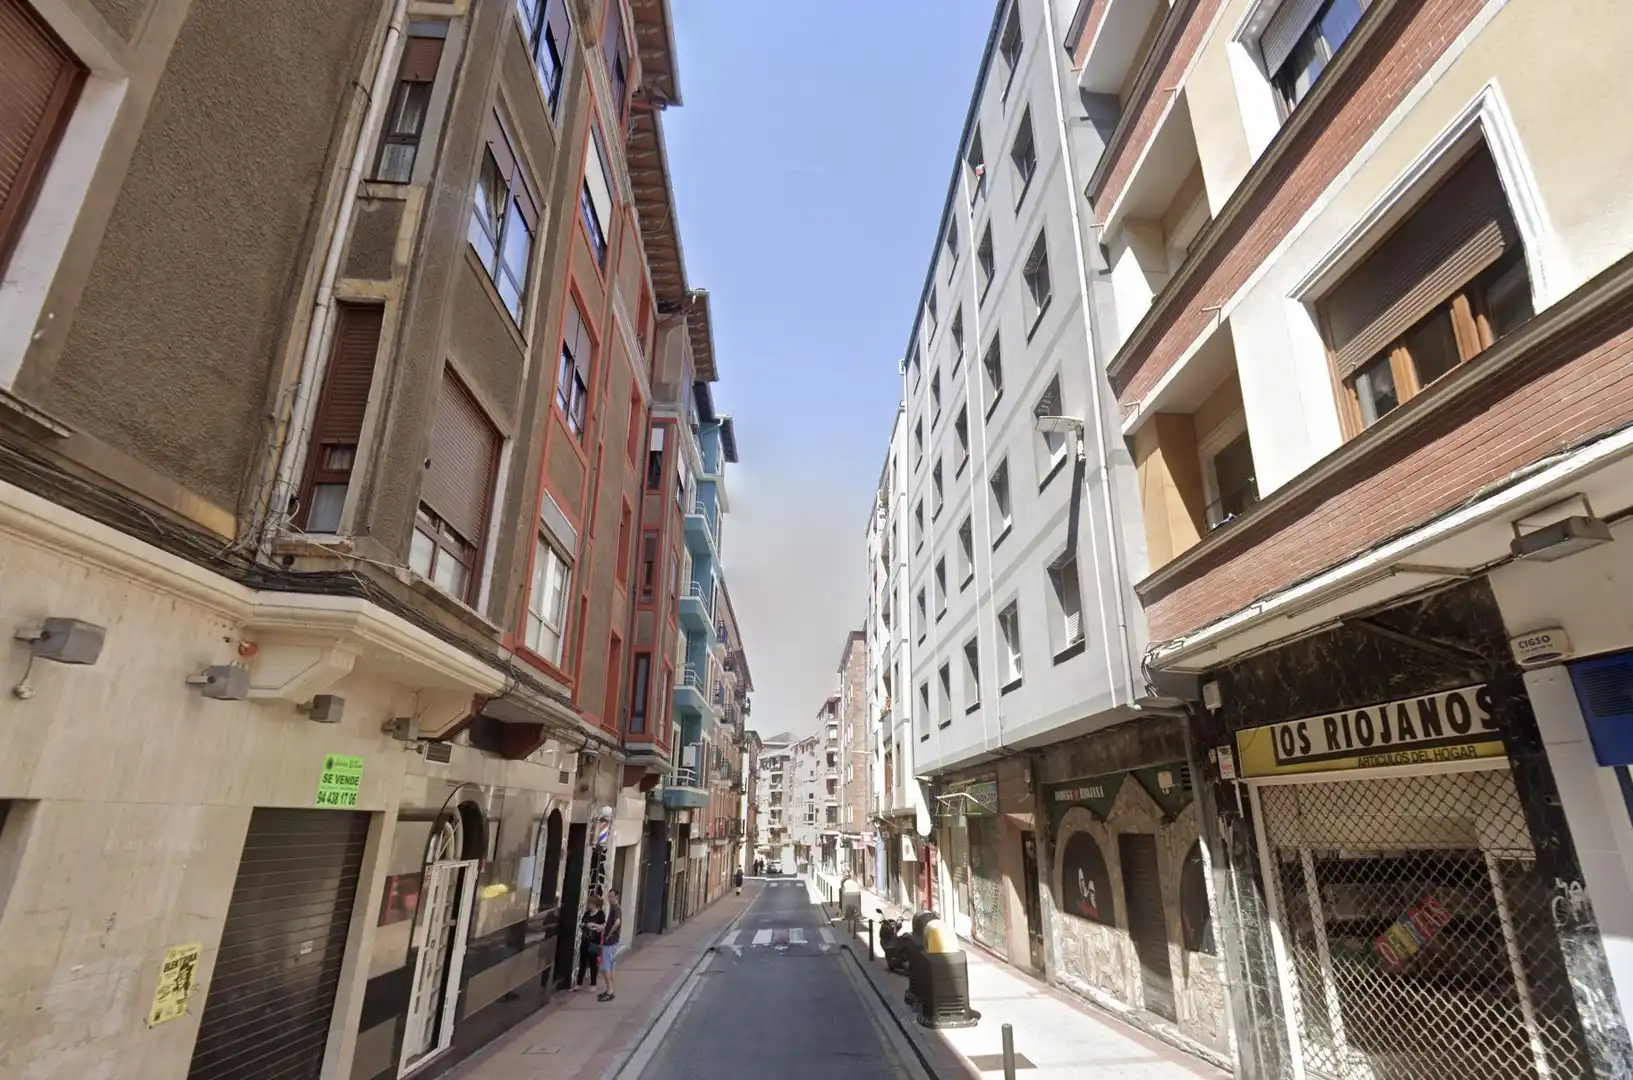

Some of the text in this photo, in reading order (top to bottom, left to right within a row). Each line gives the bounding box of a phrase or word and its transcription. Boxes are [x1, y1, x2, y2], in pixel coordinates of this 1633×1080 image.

[1518, 635, 1550, 649] CIGSO
[1323, 687, 1496, 751] RIOJANOS
[1358, 746, 1478, 769] ARTICULOS DEL HOGAR
[322, 773, 360, 786] SE VENDE
